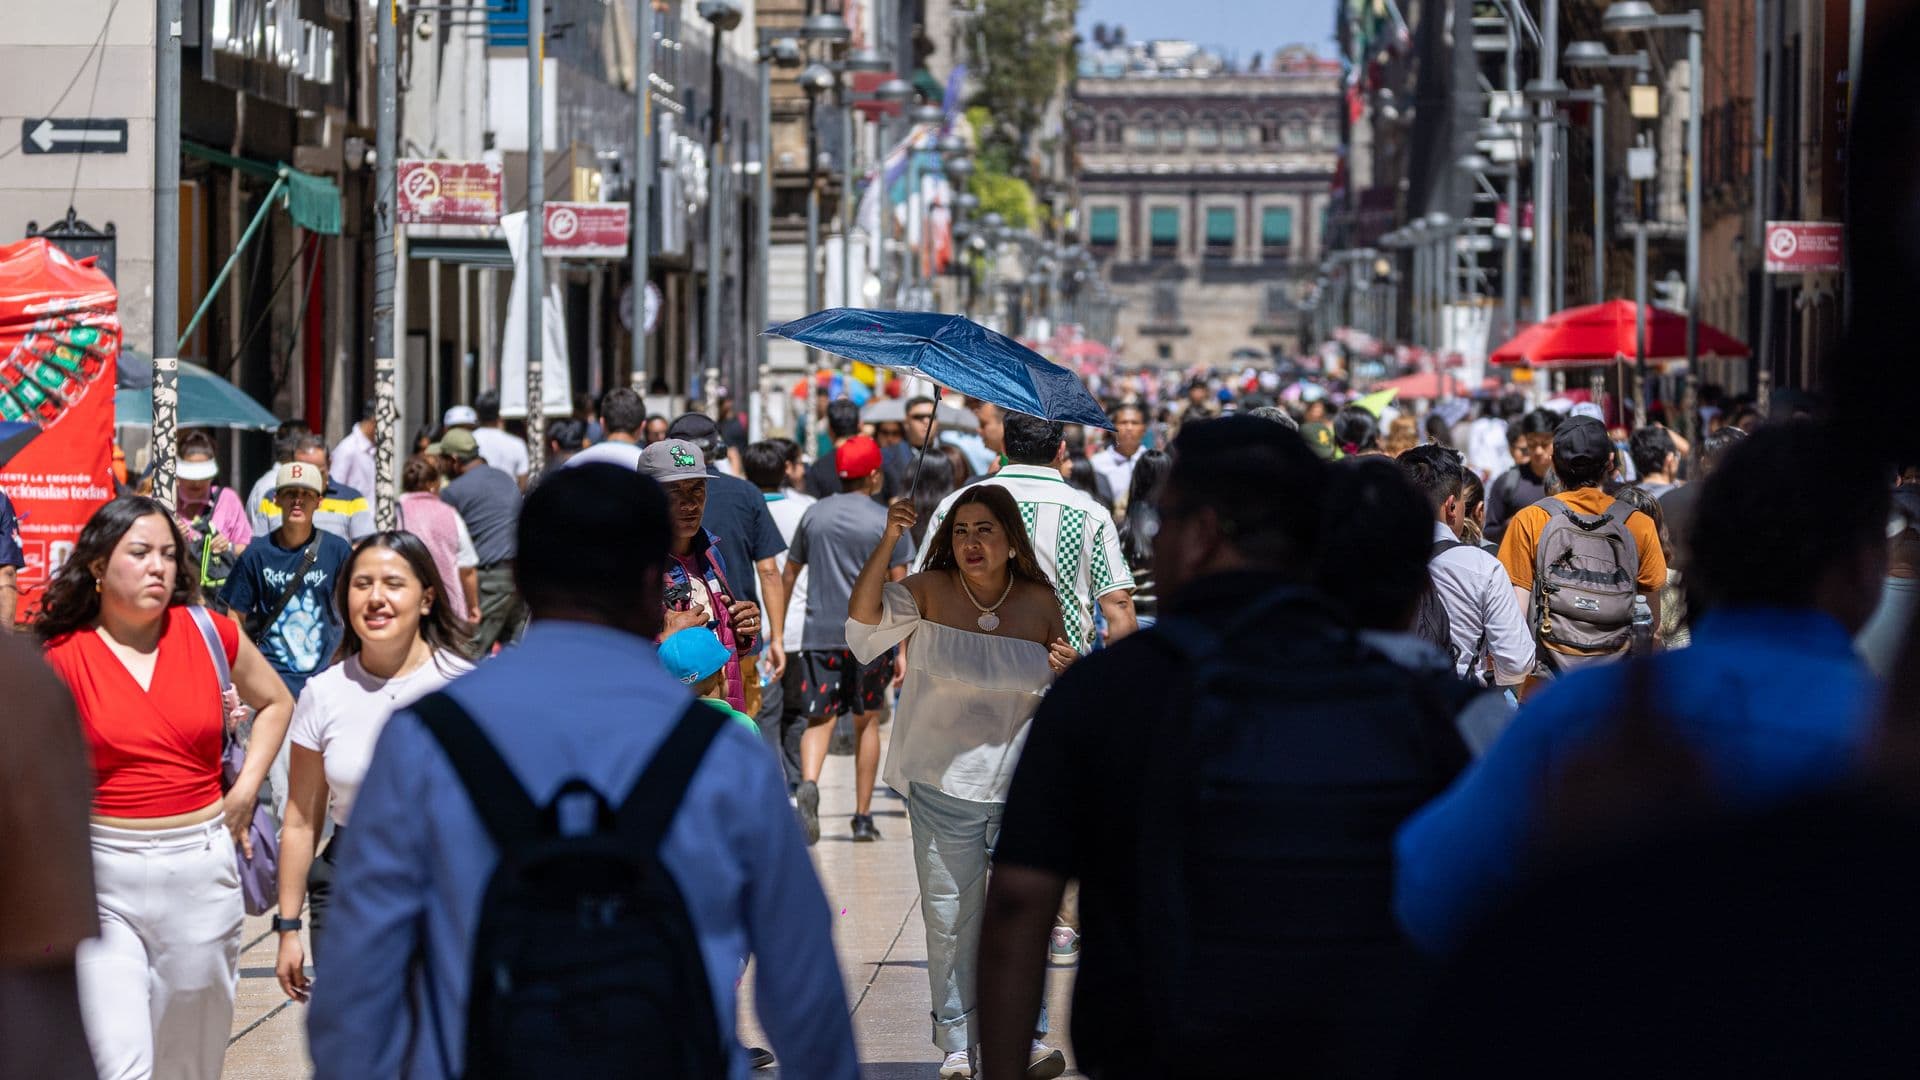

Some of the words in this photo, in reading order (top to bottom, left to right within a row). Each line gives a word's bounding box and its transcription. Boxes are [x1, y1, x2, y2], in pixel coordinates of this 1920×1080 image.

[292, 465, 303, 478] B
[30, 474, 43, 483] LA
[70, 484, 108, 499] todas
